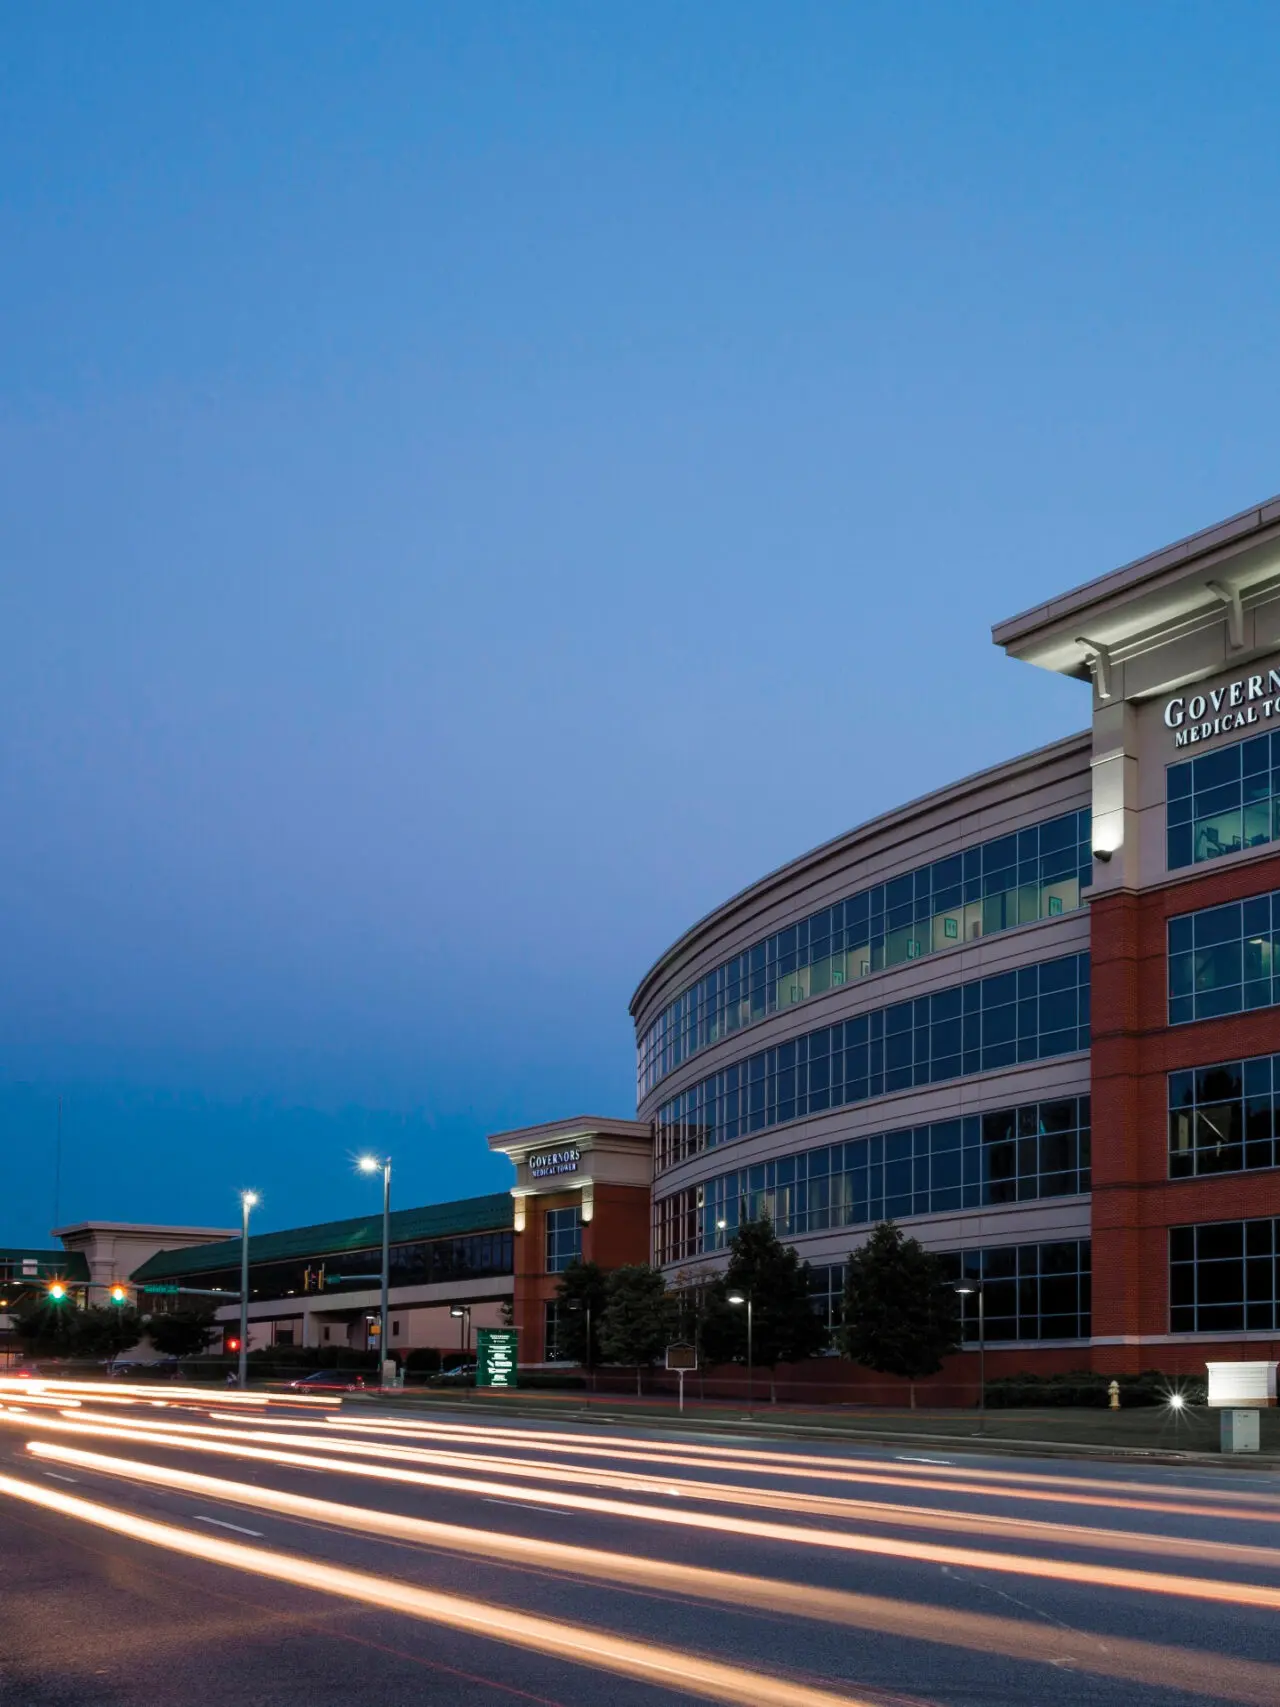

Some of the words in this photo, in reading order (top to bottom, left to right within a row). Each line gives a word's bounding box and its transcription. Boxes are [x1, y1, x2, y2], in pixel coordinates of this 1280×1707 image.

[1175, 709, 1258, 748] MEDICAL
[529, 1149, 580, 1168] GOVERNORS
[532, 1167, 556, 1177] MEDICAL
[557, 1163, 576, 1173] TOWER
